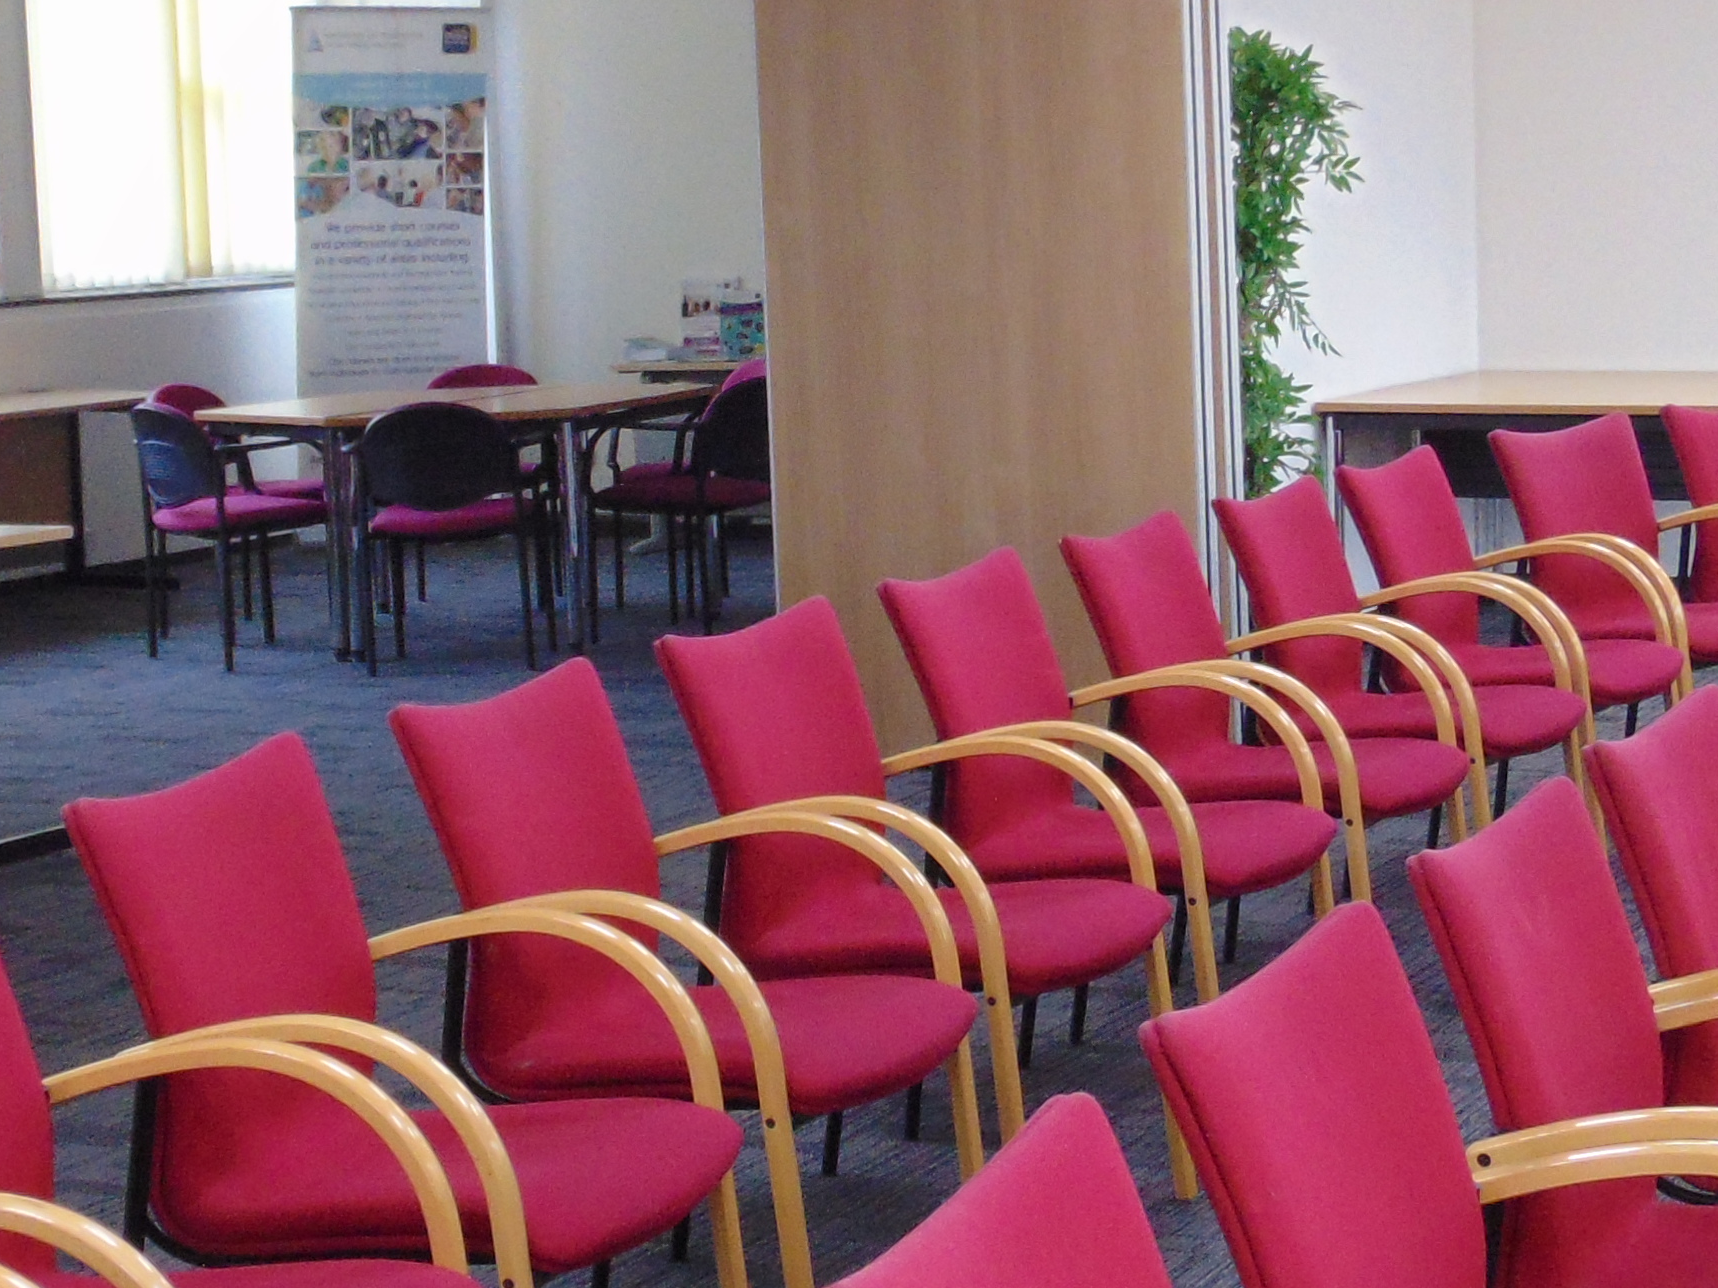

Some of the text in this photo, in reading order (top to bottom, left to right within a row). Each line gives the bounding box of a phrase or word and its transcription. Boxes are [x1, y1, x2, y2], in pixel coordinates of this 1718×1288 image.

[325, 222, 461, 234] We provide short courses
[310, 237, 472, 250] and professional qualifications
[338, 255, 371, 266] variety
[375, 254, 388, 264] of
[390, 255, 418, 264] areas
